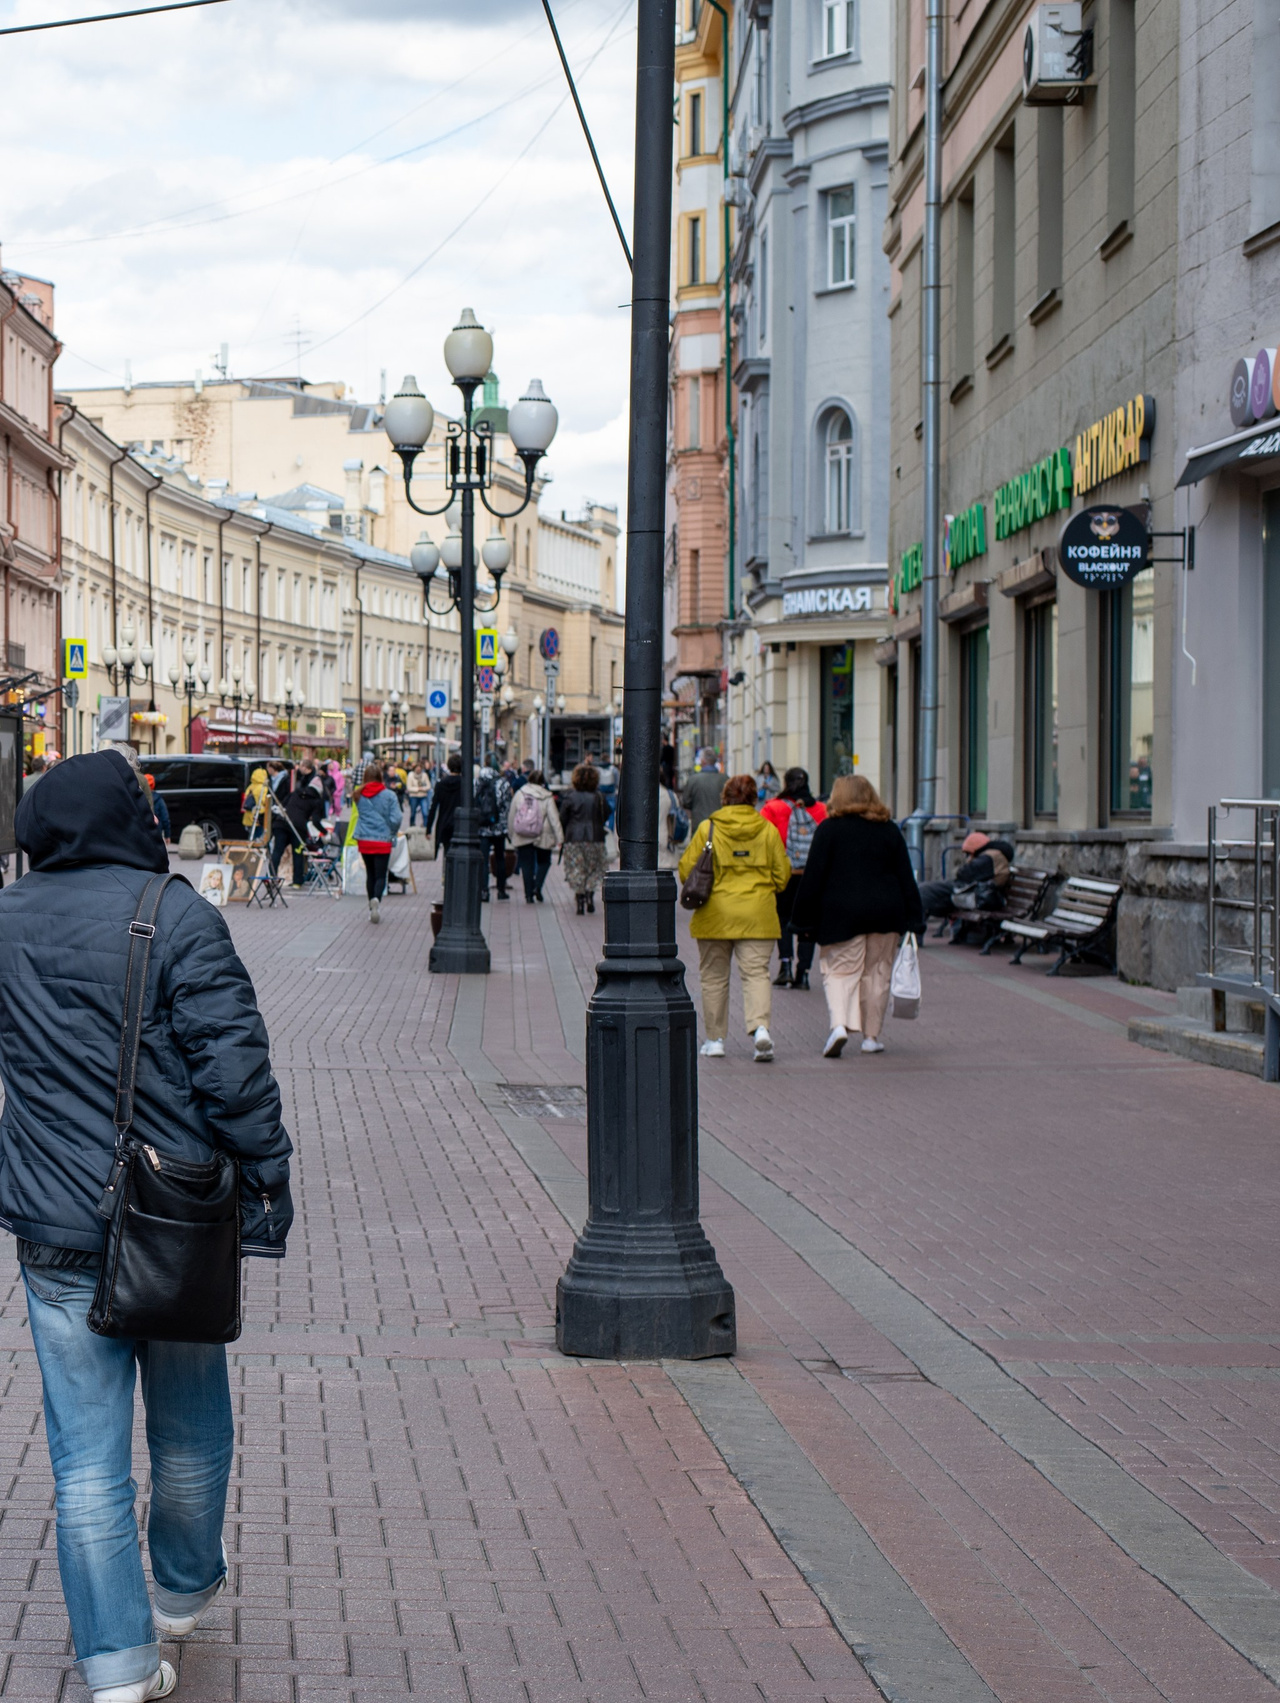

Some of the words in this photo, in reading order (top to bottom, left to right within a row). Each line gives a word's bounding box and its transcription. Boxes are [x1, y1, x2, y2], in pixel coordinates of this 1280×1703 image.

[1074, 393, 1147, 497] АНТИКВАР
[994, 454, 1058, 542] PHARMACY
[1067, 543, 1142, 559] КОФЕЙНЯ
[1078, 562, 1130, 572] BLACKOUT
